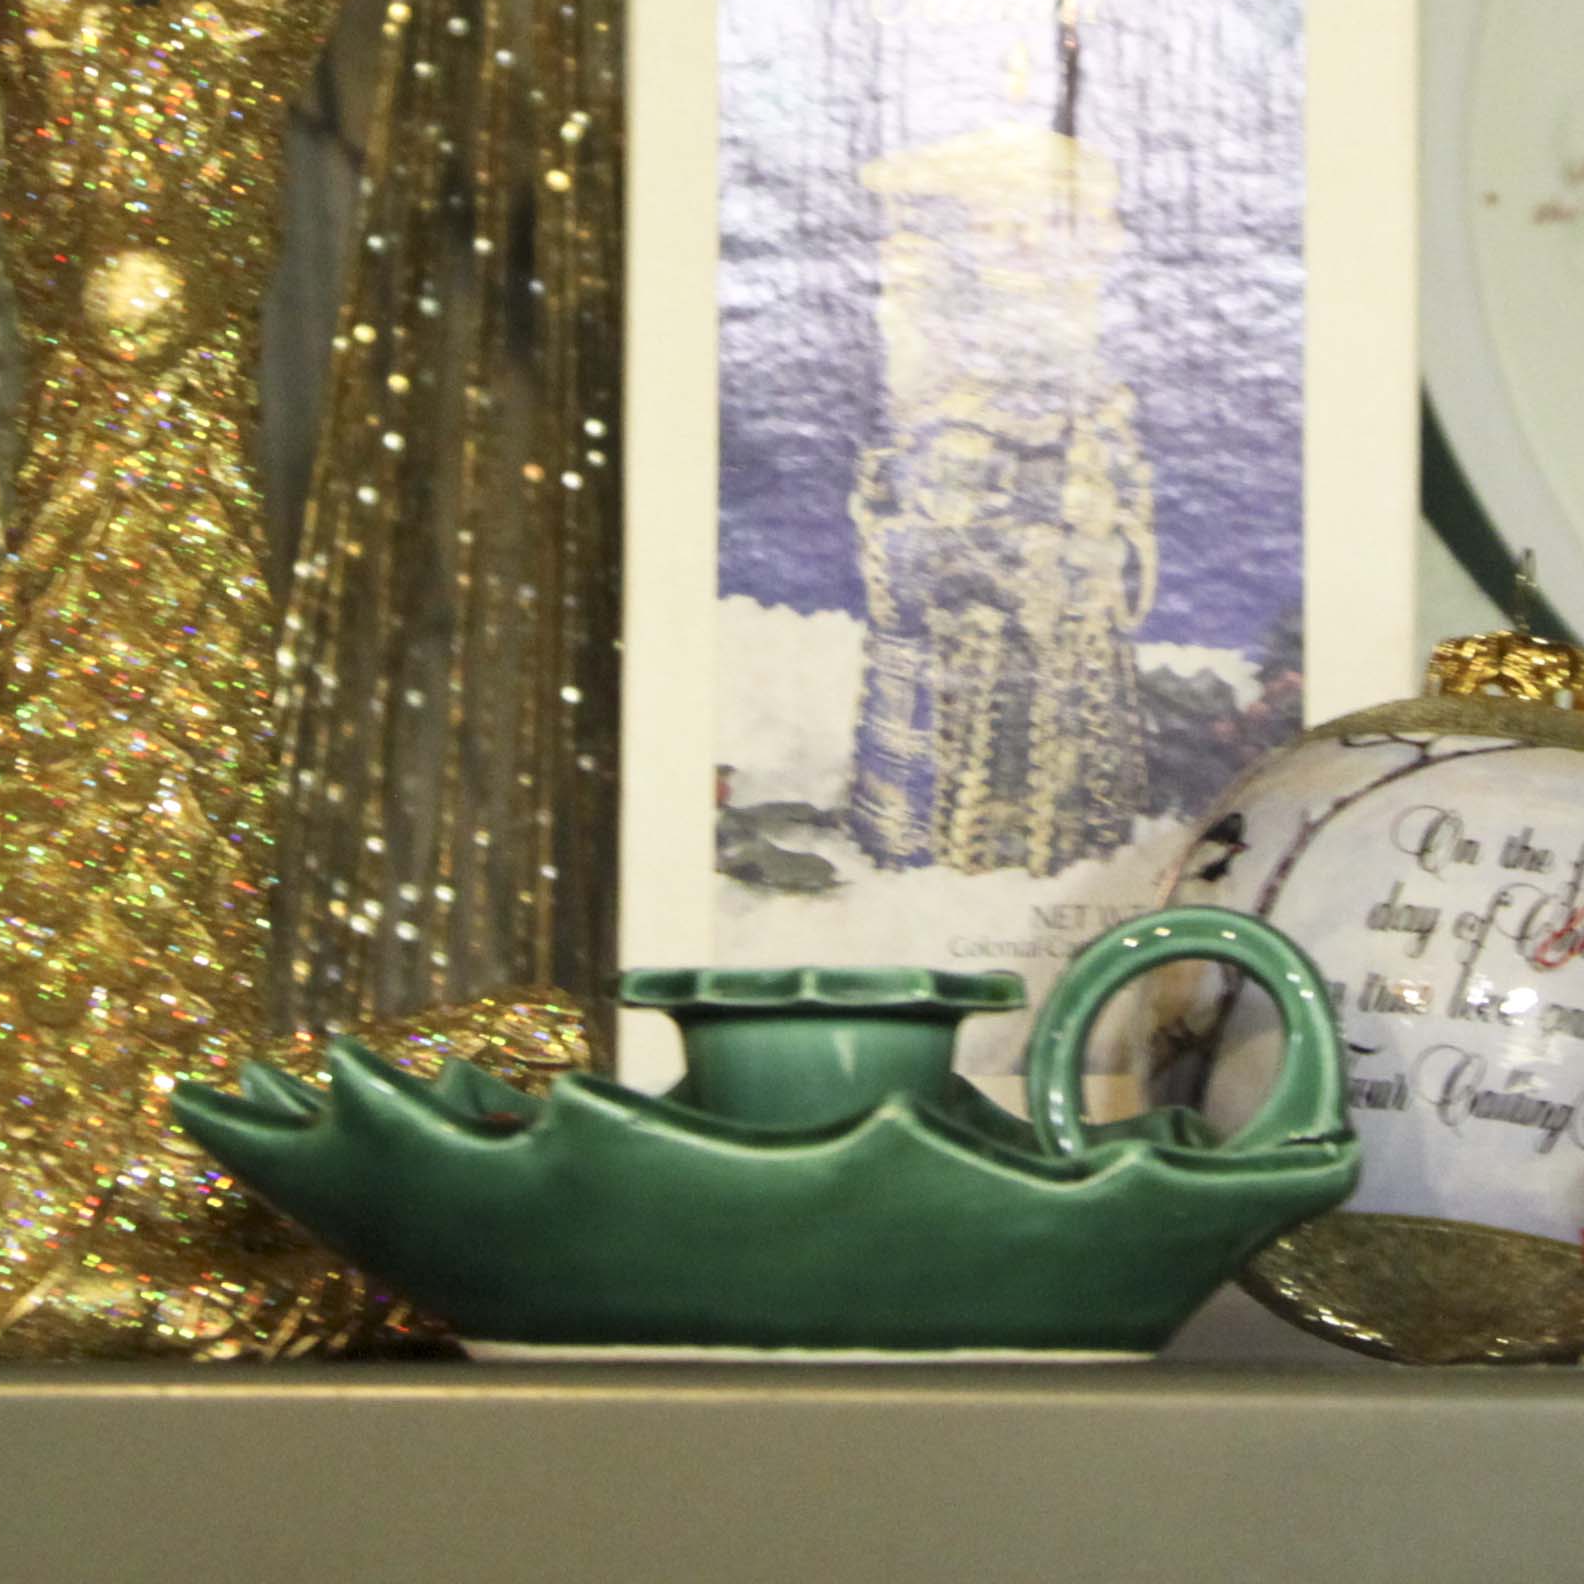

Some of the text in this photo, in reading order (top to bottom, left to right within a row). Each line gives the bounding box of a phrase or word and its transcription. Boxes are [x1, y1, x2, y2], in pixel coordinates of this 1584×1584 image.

[1391, 804, 1481, 882] On
[1499, 826, 1556, 875] the
[1364, 880, 1442, 960] day
